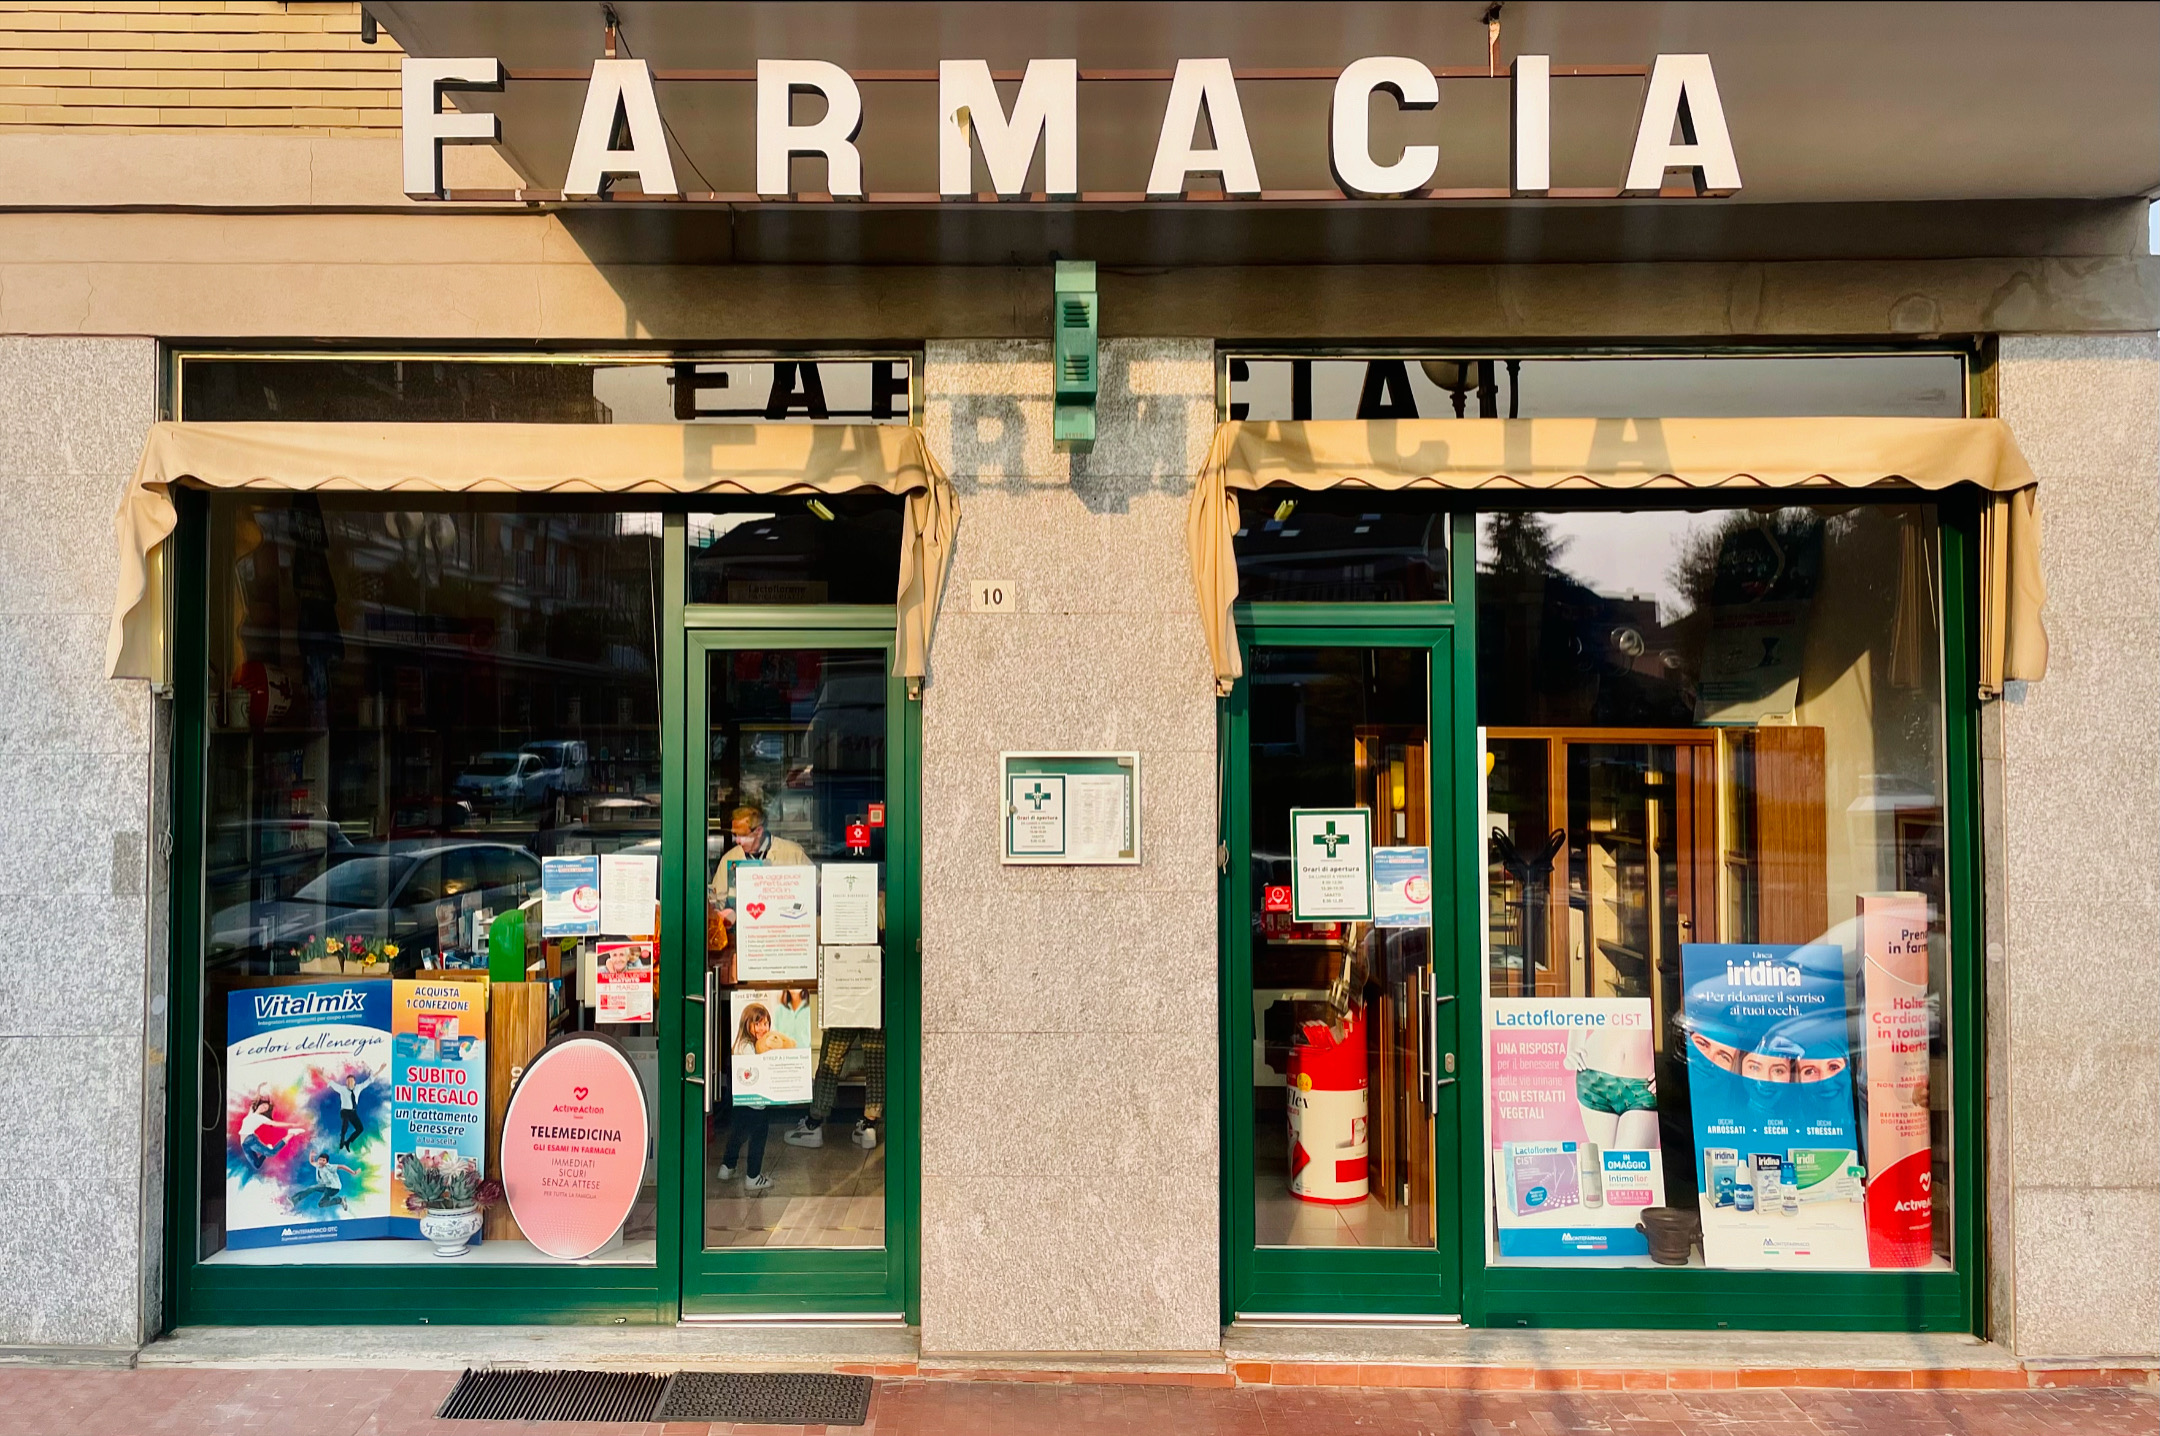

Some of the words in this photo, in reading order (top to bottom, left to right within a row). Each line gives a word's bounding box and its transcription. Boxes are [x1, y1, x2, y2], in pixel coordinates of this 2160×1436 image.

[402, 53, 1744, 201] FARMACIA
[982, 588, 1003, 605] 10
[1888, 942, 1901, 954] in
[1726, 960, 1802, 987] iridina
[414, 986, 460, 998] ACQUISTA
[1705, 991, 1724, 1002] Per
[1727, 990, 1775, 1003] ridonare
[1777, 991, 1784, 1003] il
[1786, 992, 1825, 1004] sorriso
[254, 988, 368, 1019] Vitalmix
[406, 998, 411, 1009] 1
[412, 999, 469, 1011] CONFEZIONE
[1730, 1005, 1740, 1016] ai
[1742, 1004, 1765, 1016] tuoi
[1767, 1004, 1803, 1017] occhi.
[1495, 1009, 1606, 1026] Lactoflorene
[1611, 1013, 1642, 1026] CIST
[1877, 1027, 1891, 1039] in
[247, 1036, 291, 1055] colori
[294, 1032, 385, 1057] dell'energia
[1496, 1042, 1518, 1055] UNA
[1519, 1042, 1566, 1055] RISPOSTA
[1497, 1060, 1510, 1072] per
[1512, 1058, 1517, 1070] il
[1519, 1058, 1560, 1070] benessere
[408, 1066, 466, 1085] SUBITO
[1498, 1076, 1518, 1087] delle
[1519, 1076, 1532, 1086] vie
[395, 1086, 412, 1102] IN
[417, 1087, 479, 1106] REGALO
[1498, 1090, 1519, 1103] CON
[1520, 1090, 1566, 1103] ESTRATTI
[552, 1104, 605, 1114] ActiveAction
[1500, 1106, 1544, 1120] VEGETALI
[396, 1108, 409, 1119] un
[412, 1109, 478, 1124] trattamento
[409, 1120, 465, 1136] benessere
[530, 1126, 622, 1142] TELEMEDICINA
[1707, 1126, 1746, 1134] ARROSSATI
[1763, 1126, 1789, 1135] SECCHI
[1806, 1126, 1843, 1136] STRESSATI
[533, 1144, 546, 1152] GLI
[548, 1144, 569, 1152] ESAMI
[571, 1145, 580, 1153] IN
[581, 1146, 616, 1155] FARMACIA
[1514, 1146, 1558, 1156] Lactoflorene
[1714, 1152, 1735, 1160] iridina
[551, 1158, 596, 1169] IMMEDIATI
[1515, 1156, 1534, 1166] CIST
[1607, 1160, 1647, 1170] OMAGGIO
[1758, 1156, 1780, 1166] iridina
[558, 1168, 587, 1178] SICURI
[542, 1178, 570, 1188] SENZA
[572, 1180, 600, 1190] ATTESE
